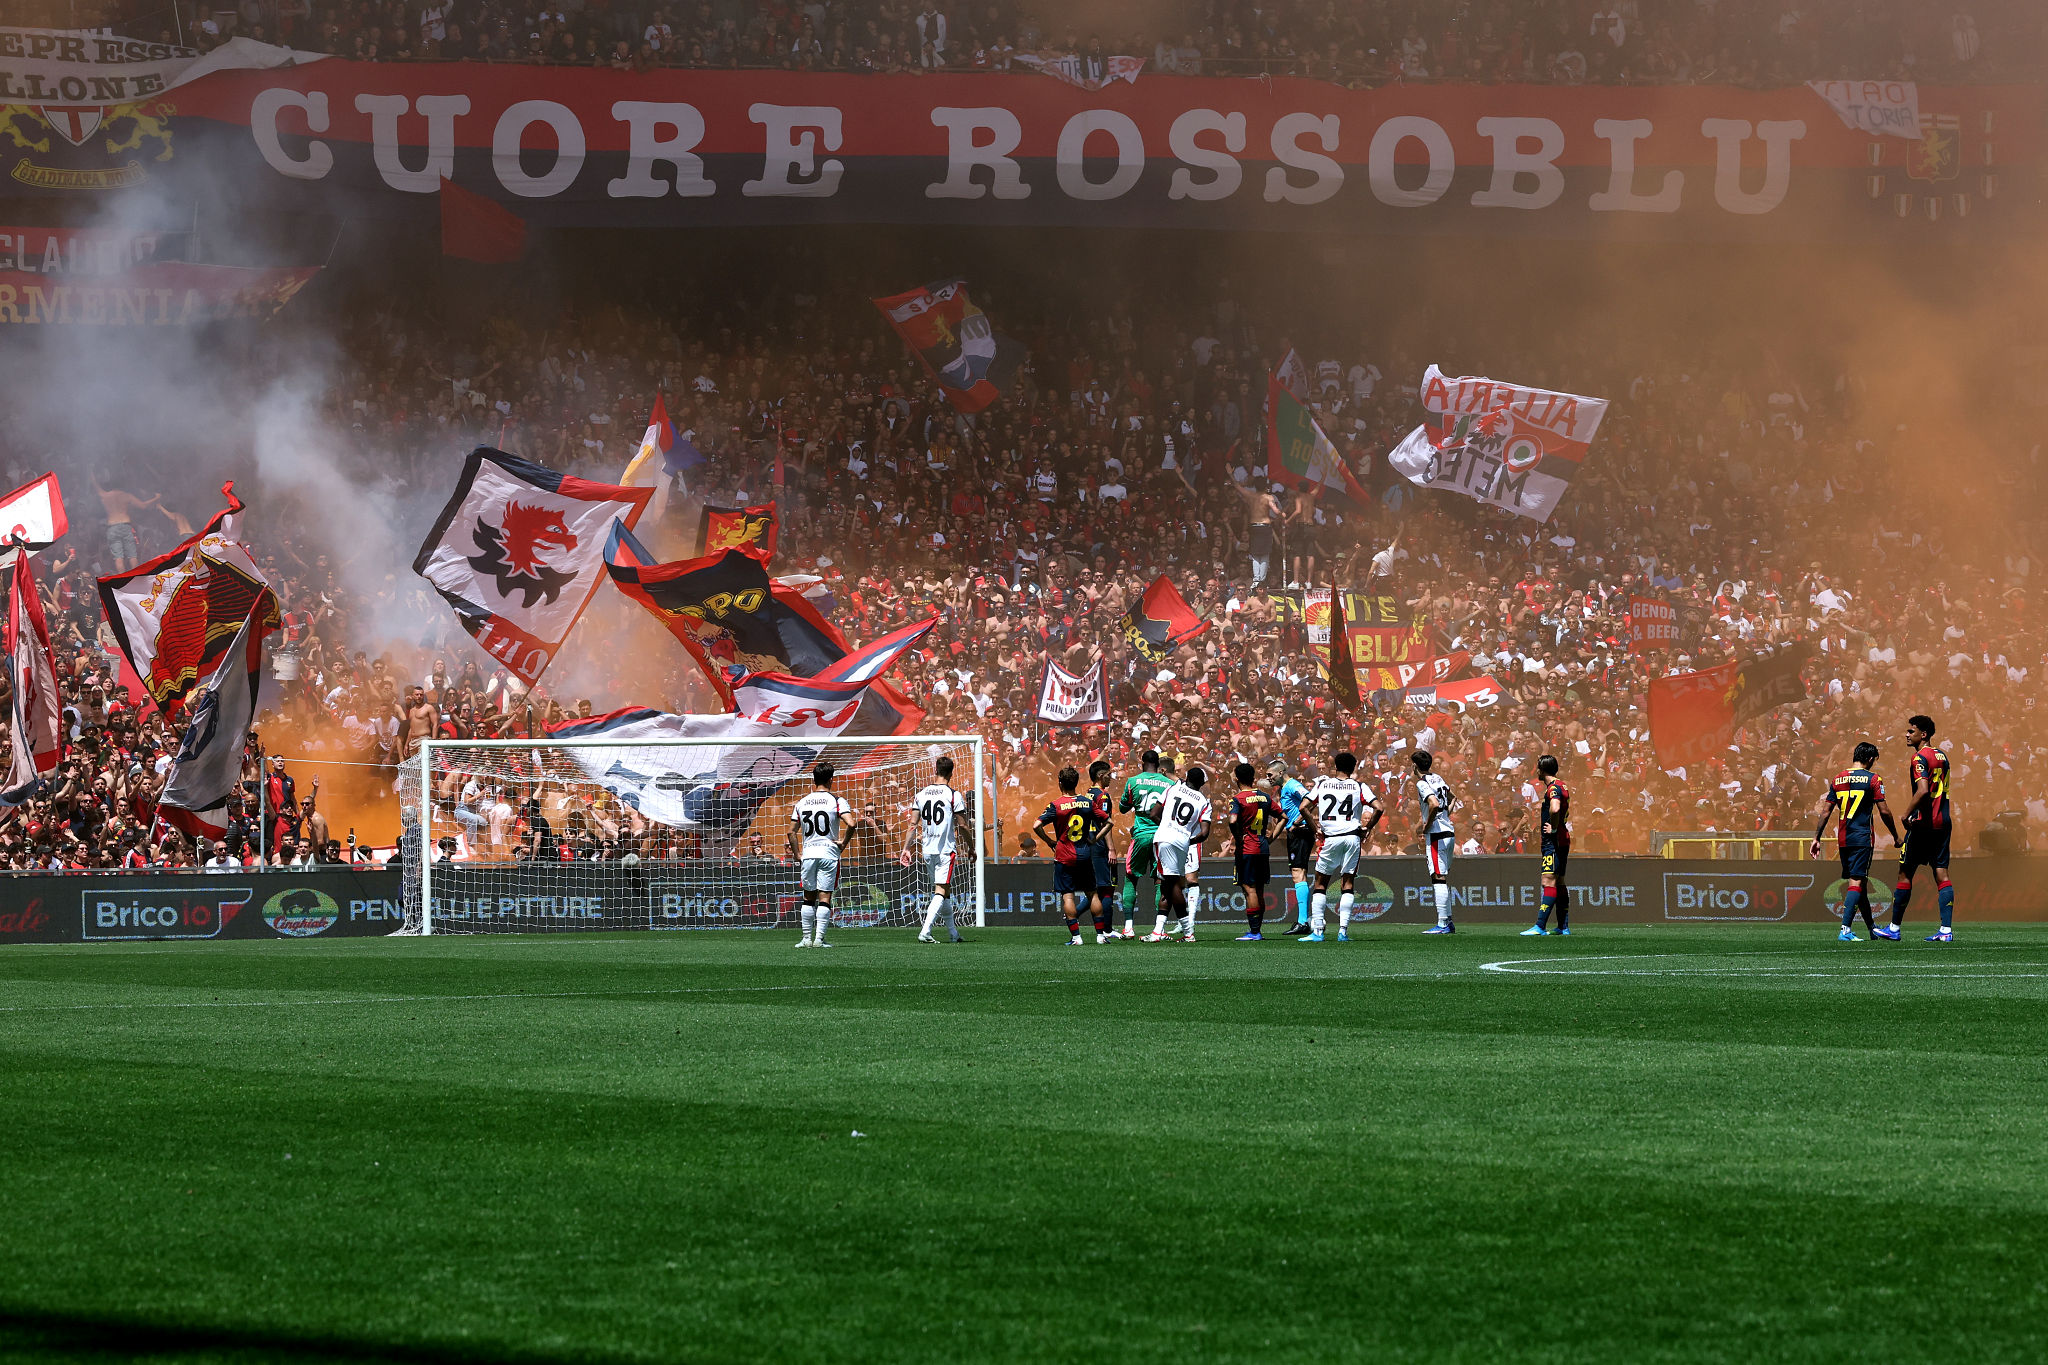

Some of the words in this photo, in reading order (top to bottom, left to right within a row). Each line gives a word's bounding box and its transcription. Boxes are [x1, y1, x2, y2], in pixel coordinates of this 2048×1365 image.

[251, 87, 844, 198] CUORE
[925, 106, 1807, 214] ROSSOBLU
[1632, 602, 1677, 621] GENOA
[1632, 626, 1644, 642] &
[1646, 624, 1680, 640] BEER
[1047, 679, 1098, 706] 1893
[921, 799, 946, 826] 46
[1060, 800, 1090, 811] BALDANZI
[1171, 795, 1195, 826] 19
[1321, 793, 1354, 821] 24
[1835, 789, 1865, 820] 77
[801, 810, 831, 837] 30
[1067, 814, 1084, 842] 8
[1250, 808, 1264, 836] 4
[1542, 854, 1553, 867] 29
[476, 897, 493, 919] E
[502, 897, 604, 919] PITTURE
[1019, 891, 1035, 913] E
[1404, 886, 1515, 907] PENELLI
[1520, 885, 1535, 907] E
[1676, 883, 1750, 909] Brico
[96, 900, 179, 928] Brico
